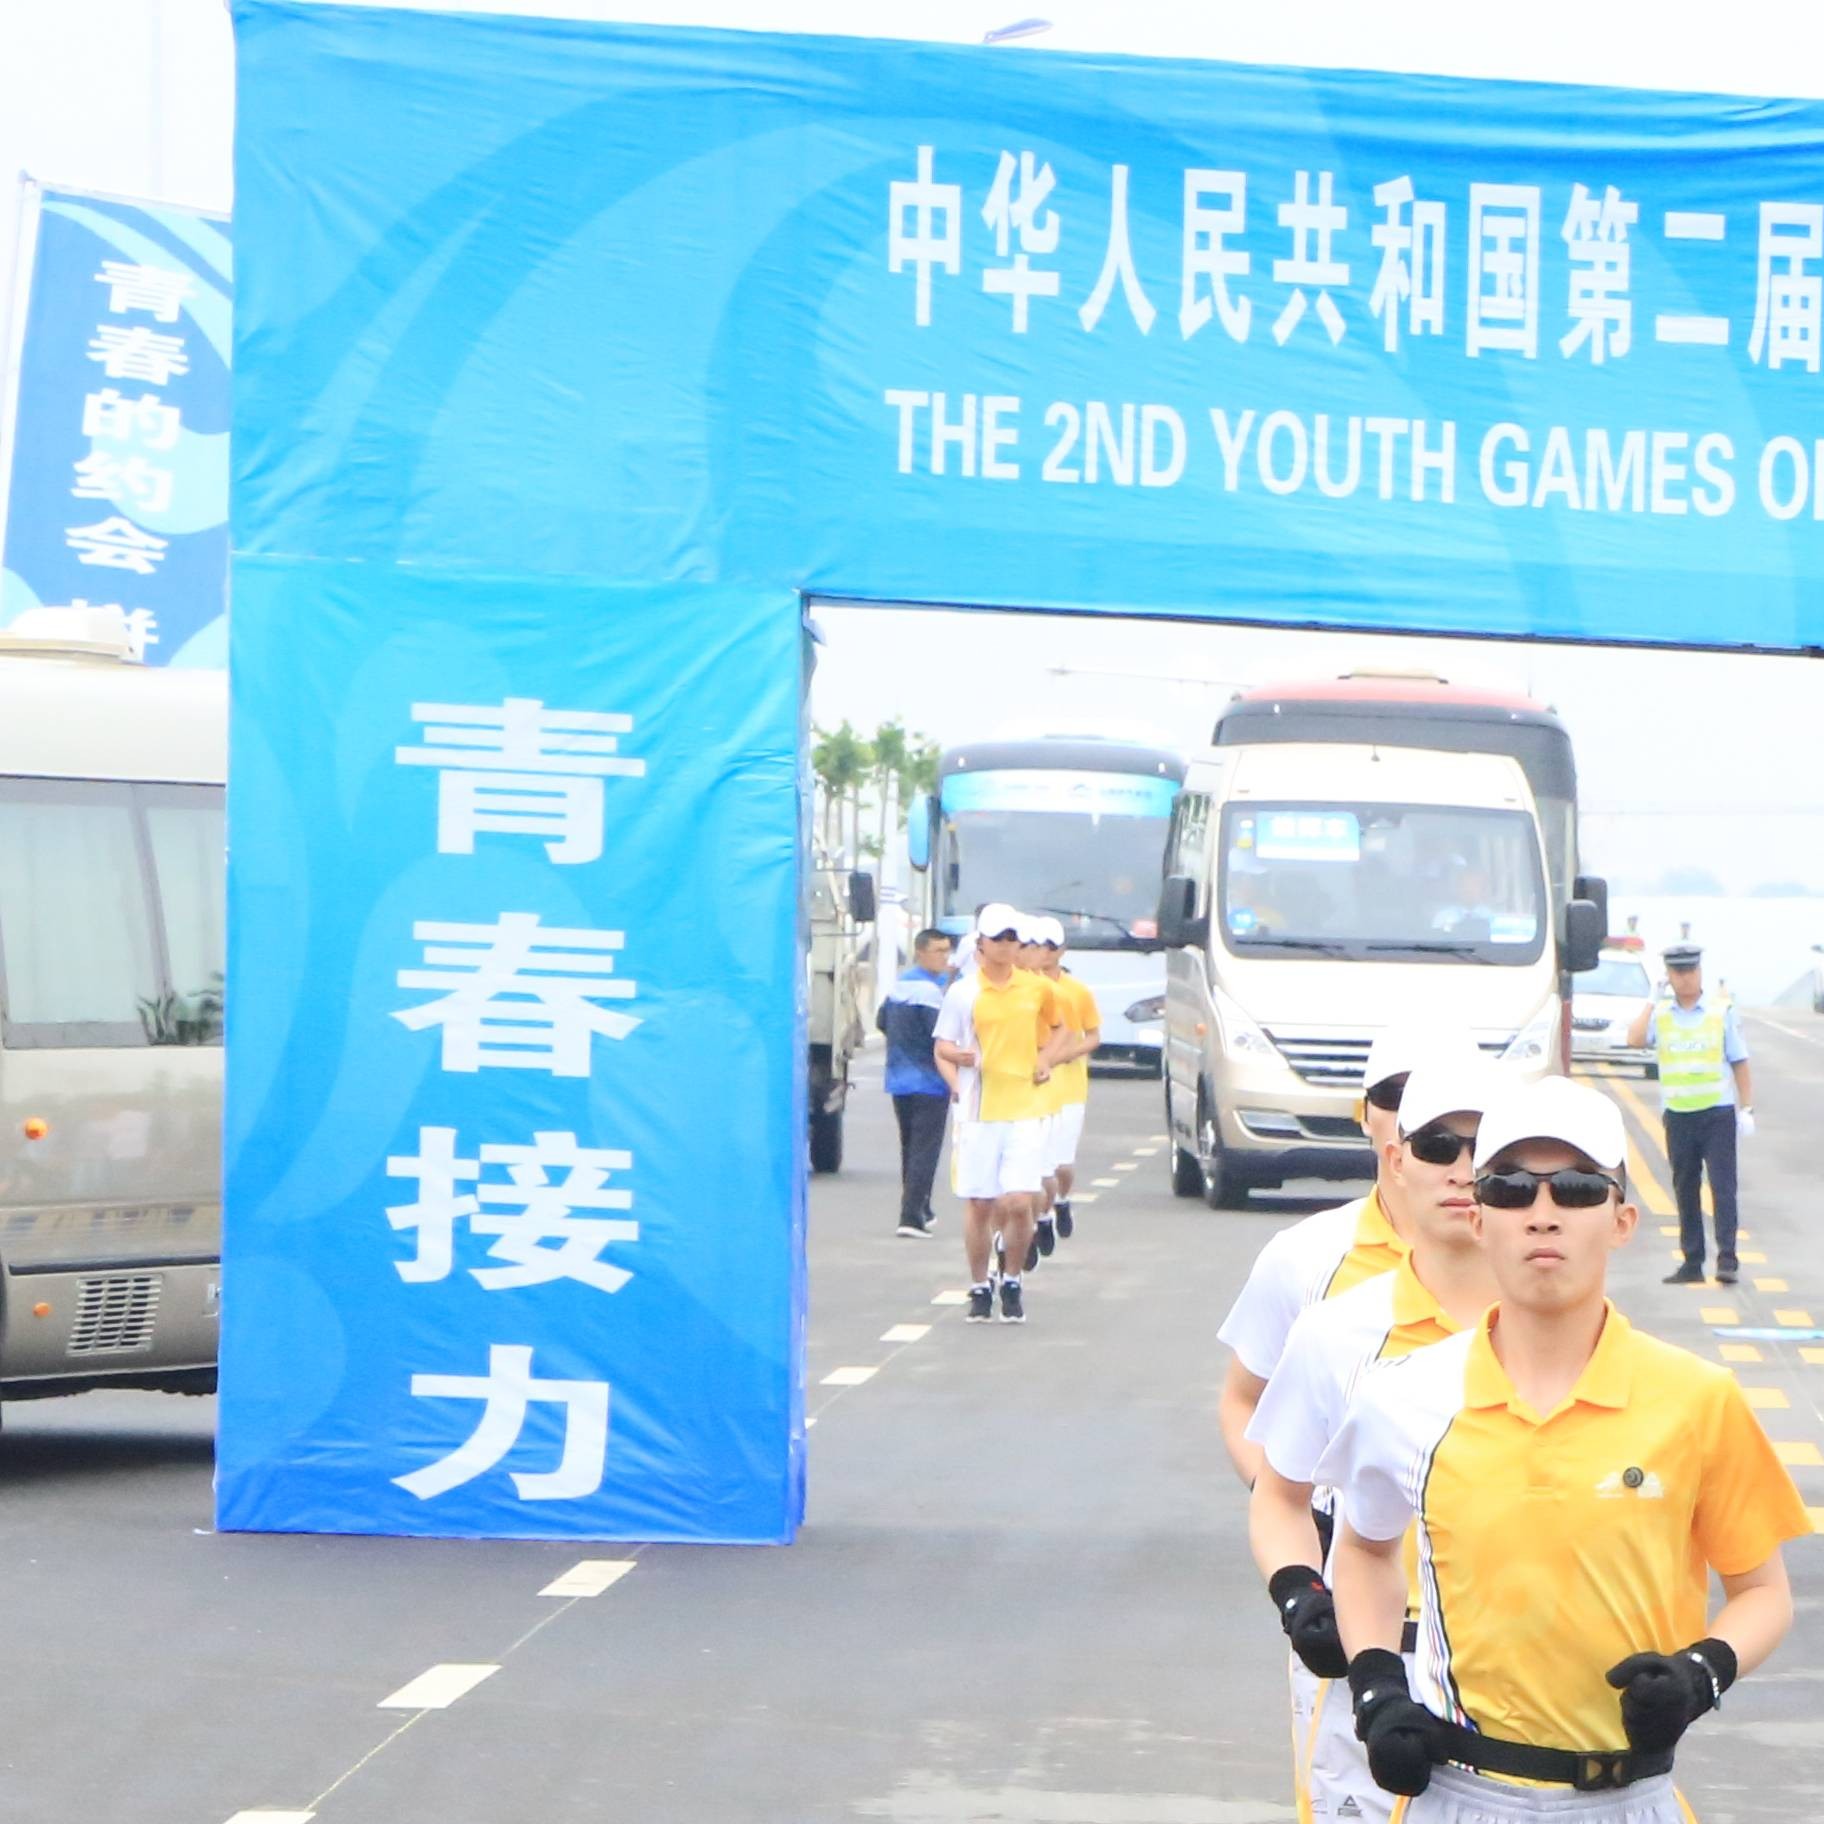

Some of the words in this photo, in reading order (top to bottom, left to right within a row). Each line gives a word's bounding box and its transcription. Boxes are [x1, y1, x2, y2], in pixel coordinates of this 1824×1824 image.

[65, 259, 191, 575] 青春的约会
[884, 389, 1020, 481] THE
[1042, 400, 1186, 488] 2ND
[1210, 406, 1456, 503] YOUTH
[1478, 419, 1737, 517] GAMES
[387, 696, 644, 1501] 青春接力
